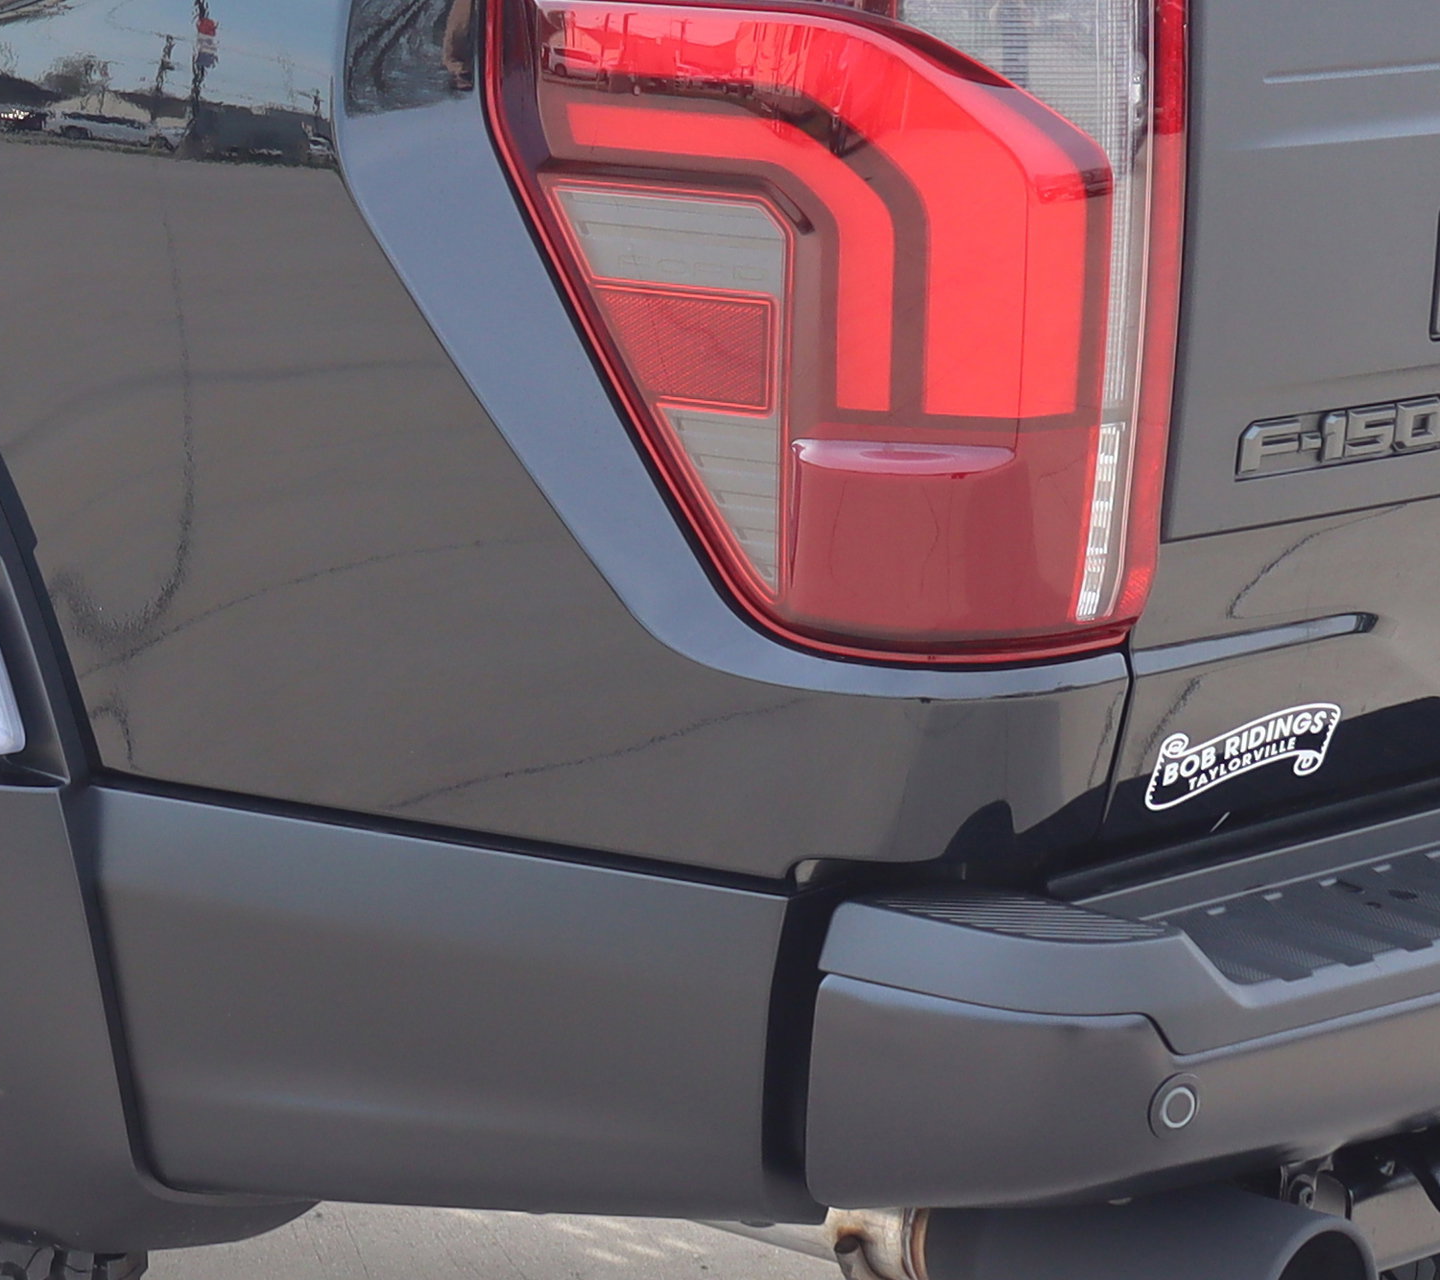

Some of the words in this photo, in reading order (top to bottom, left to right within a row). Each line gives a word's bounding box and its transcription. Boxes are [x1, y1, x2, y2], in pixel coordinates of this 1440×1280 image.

[1163, 746, 1216, 787] BOB
[1223, 710, 1327, 760] RIDINGS
[1188, 736, 1296, 791] TAYLORVILLE
